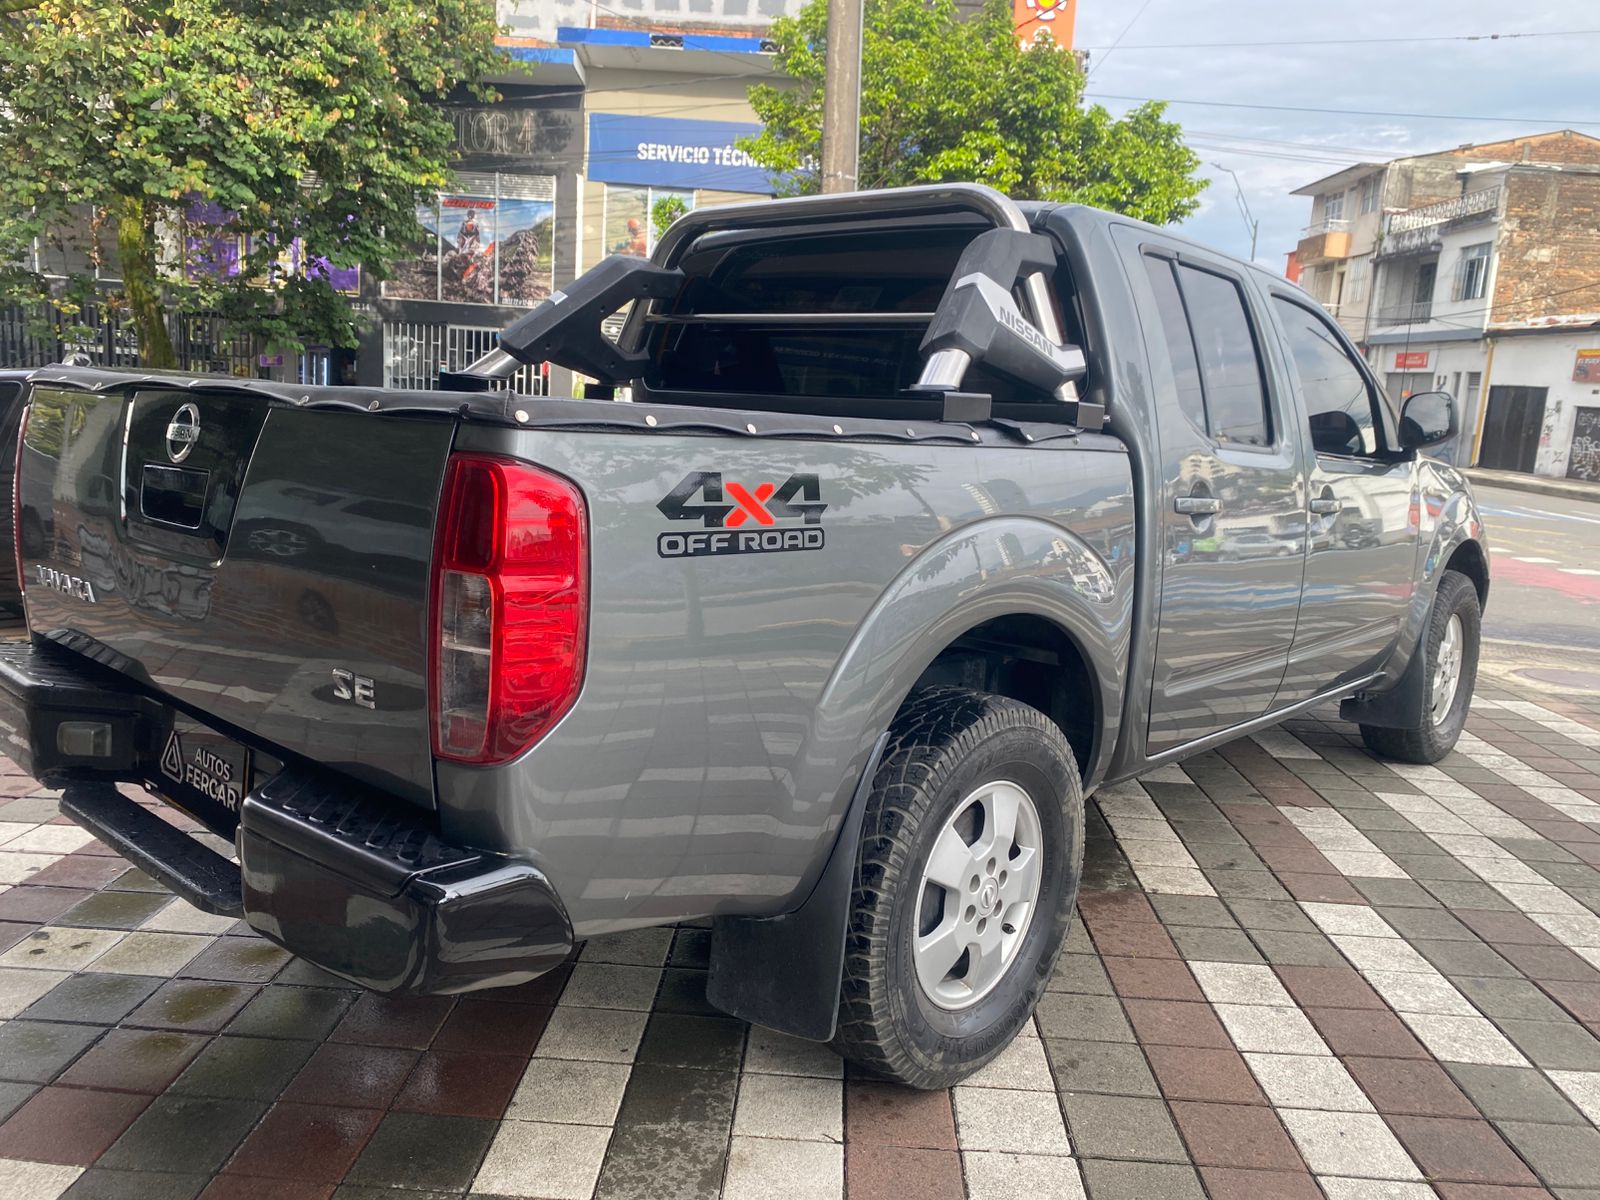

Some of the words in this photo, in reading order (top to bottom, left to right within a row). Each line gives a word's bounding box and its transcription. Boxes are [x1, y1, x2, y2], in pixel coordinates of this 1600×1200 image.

[637, 143, 709, 165] SERVICIO
[1000, 306, 1053, 357] NISSAN
[660, 534, 731, 555] OFF
[739, 529, 823, 550] ROAD
[332, 668, 376, 709] SE
[194, 747, 230, 781] AUTOS
[186, 762, 236, 812] FERCAR
